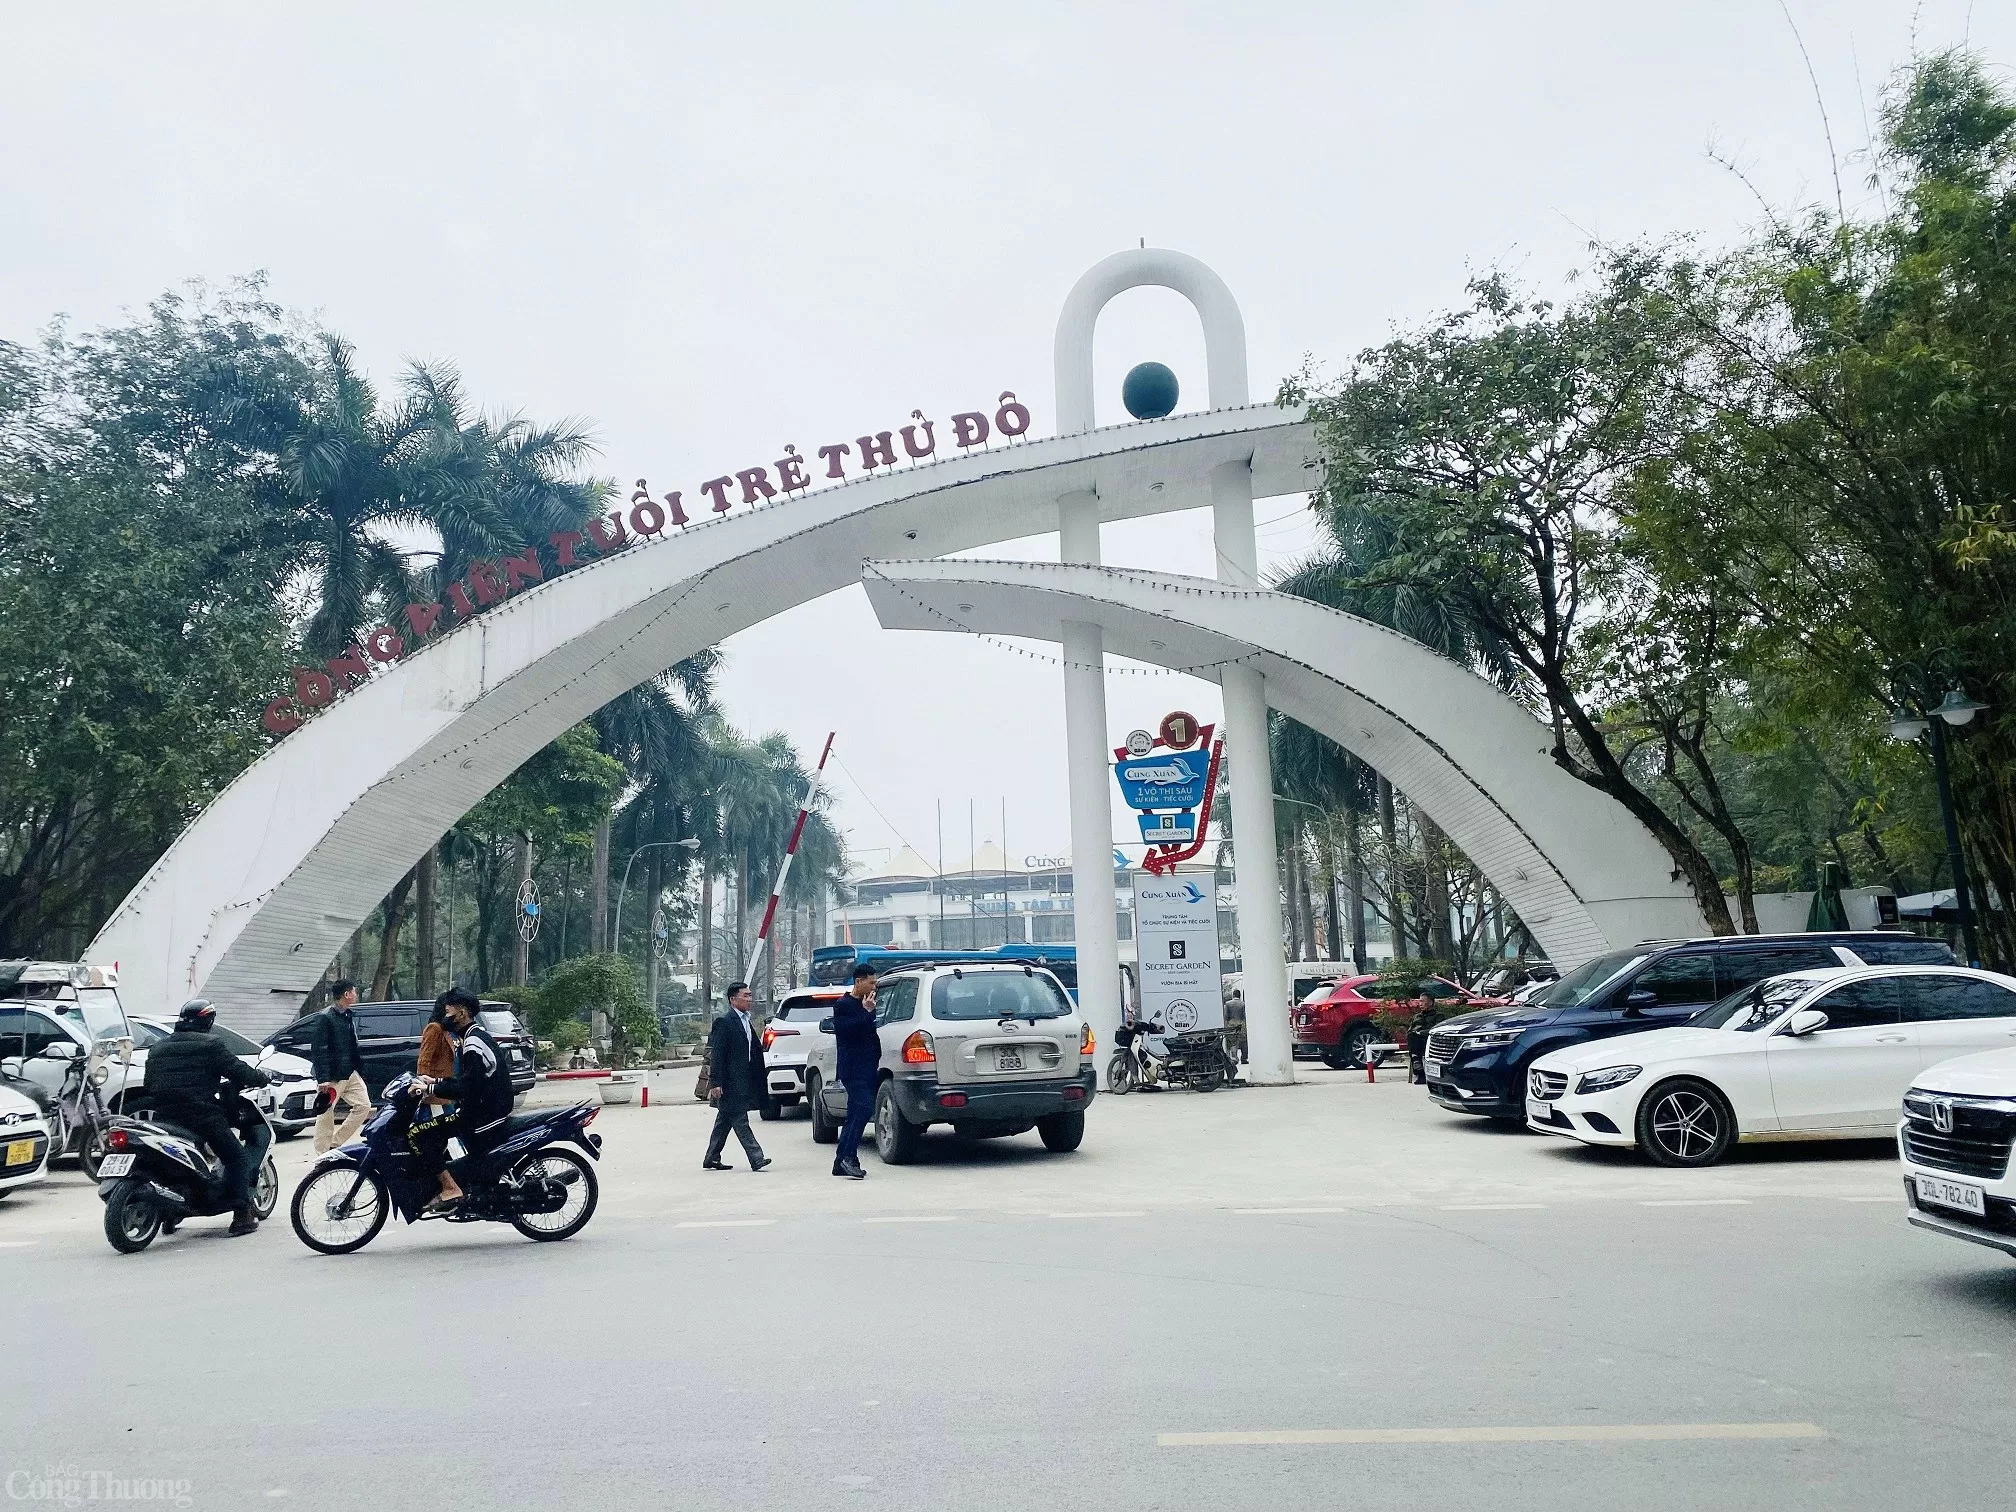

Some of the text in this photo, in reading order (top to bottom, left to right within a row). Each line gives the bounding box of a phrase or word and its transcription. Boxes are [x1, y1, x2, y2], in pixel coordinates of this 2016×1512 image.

[551, 478, 689, 566] TUỔI
[700, 443, 811, 513] TRẺ
[817, 408, 936, 479] THỦ
[950, 390, 1031, 448] ĐÔ
[1168, 718, 1186, 743] 1
[1138, 787, 1144, 796] 1
[1145, 961, 1211, 971] SECRET GARDEN
